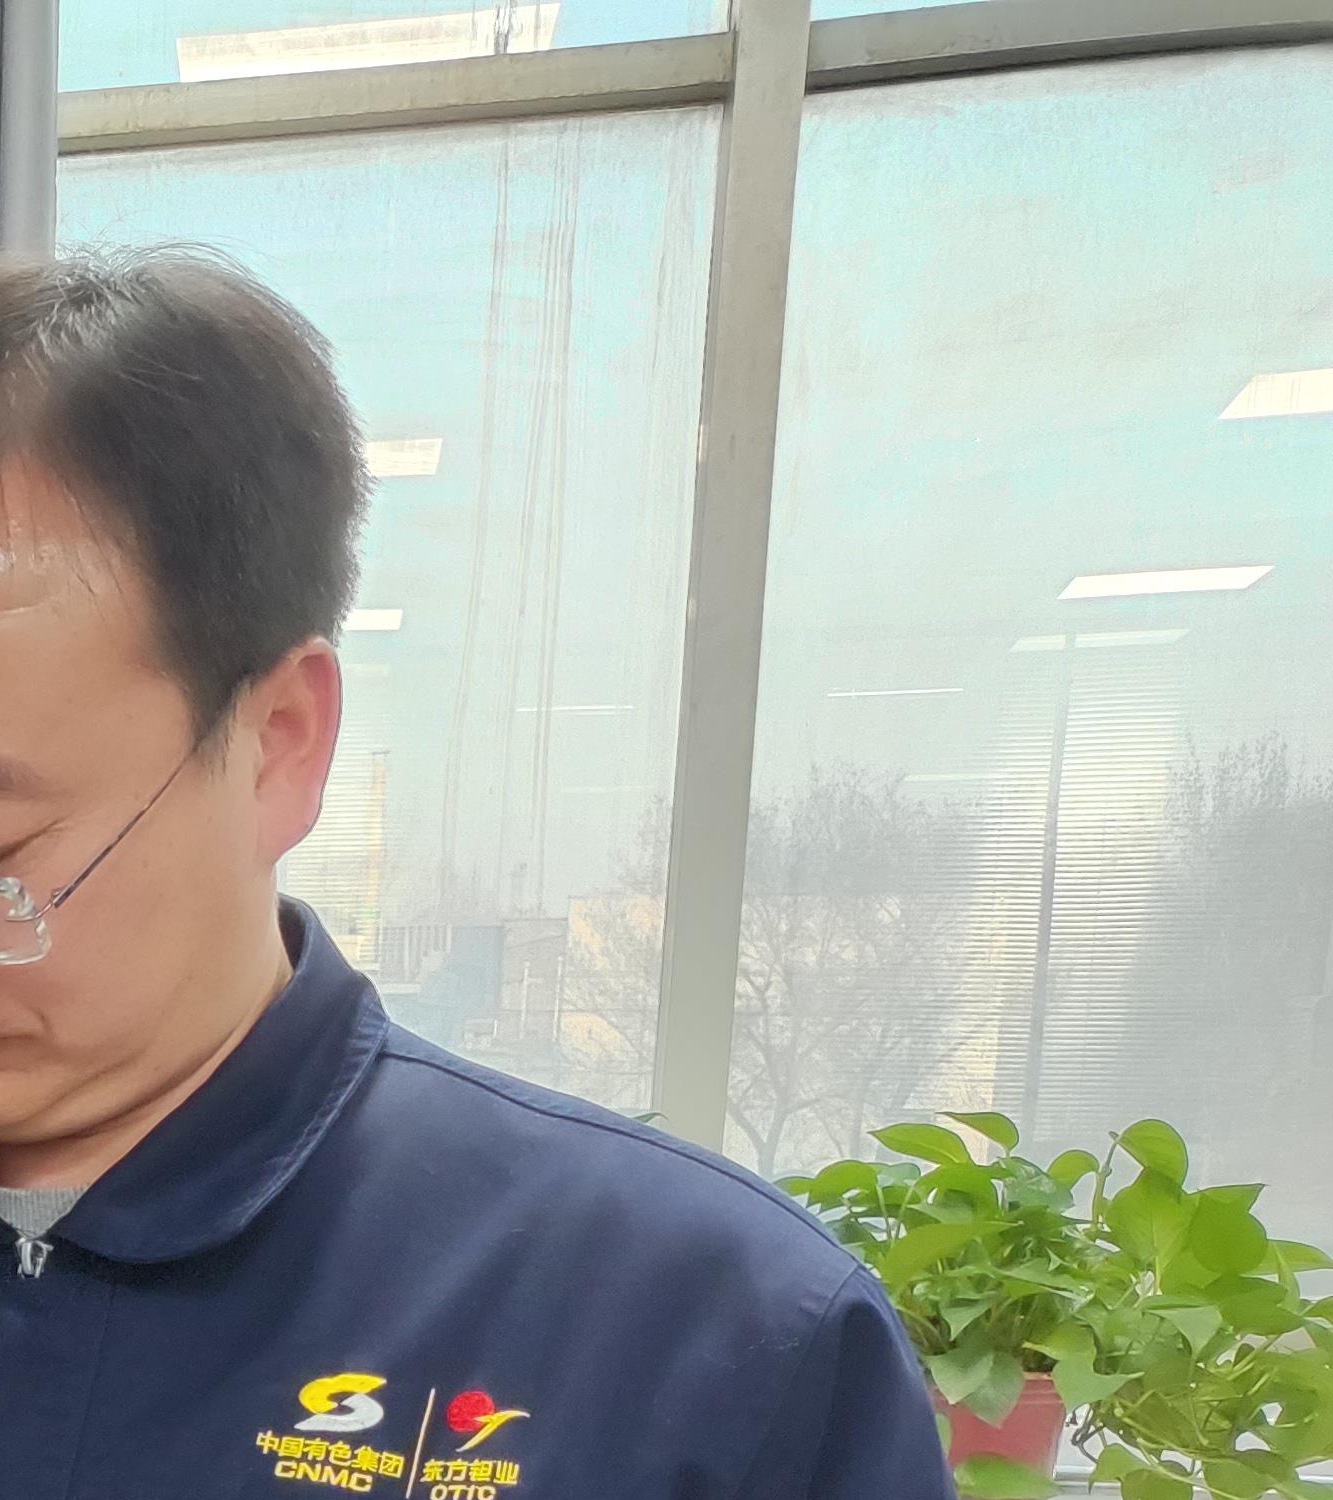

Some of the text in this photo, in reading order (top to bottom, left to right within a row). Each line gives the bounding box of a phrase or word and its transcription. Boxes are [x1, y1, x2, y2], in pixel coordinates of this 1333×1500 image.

[255, 1429, 405, 1479] 中国有色集团
[274, 1460, 373, 1492] CNMC
[419, 1458, 520, 1485] 东方钽业
